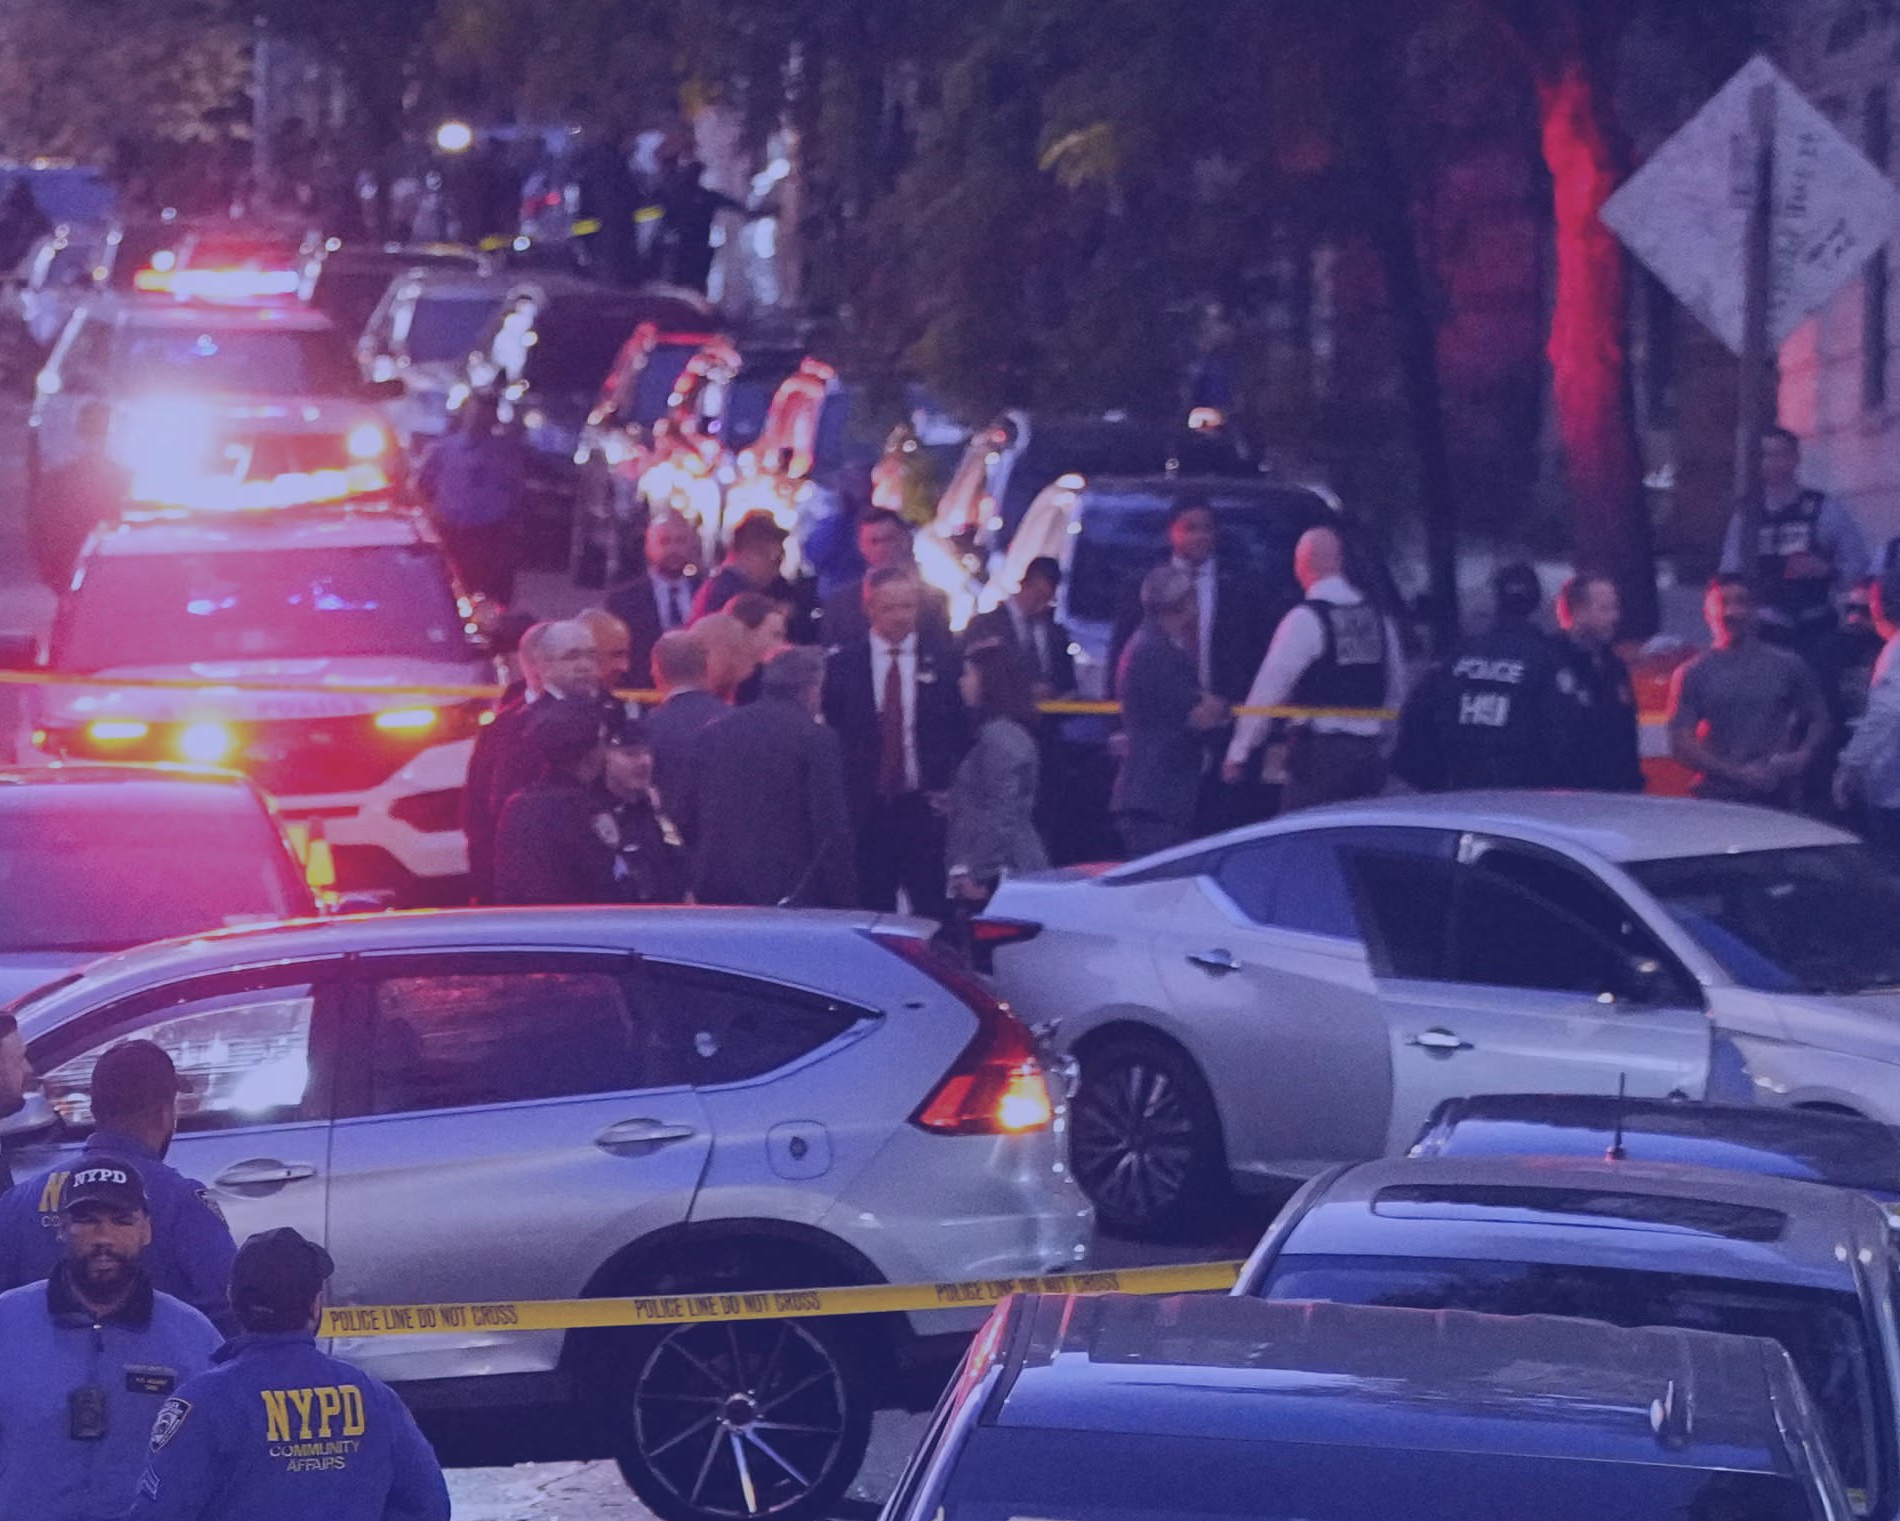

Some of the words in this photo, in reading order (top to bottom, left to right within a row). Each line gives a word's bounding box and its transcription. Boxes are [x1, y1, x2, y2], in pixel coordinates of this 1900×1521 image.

[73, 1168, 127, 1188] NYPD
[634, 1298, 683, 1319] POLICE
[688, 1296, 718, 1317] LINE
[719, 1294, 740, 1315] DO
[744, 1292, 772, 1314] NOT
[774, 1290, 821, 1313] CROSS
[330, 1310, 380, 1332] POLICE
[383, 1308, 415, 1330] LINE
[417, 1307, 437, 1329] DO
[441, 1306, 467, 1327] NOT
[471, 1304, 519, 1326] CROSS
[260, 1384, 365, 1442] NYPD
[268, 1439, 360, 1457] COMMUNITY
[286, 1455, 346, 1472] AFFAIRS
